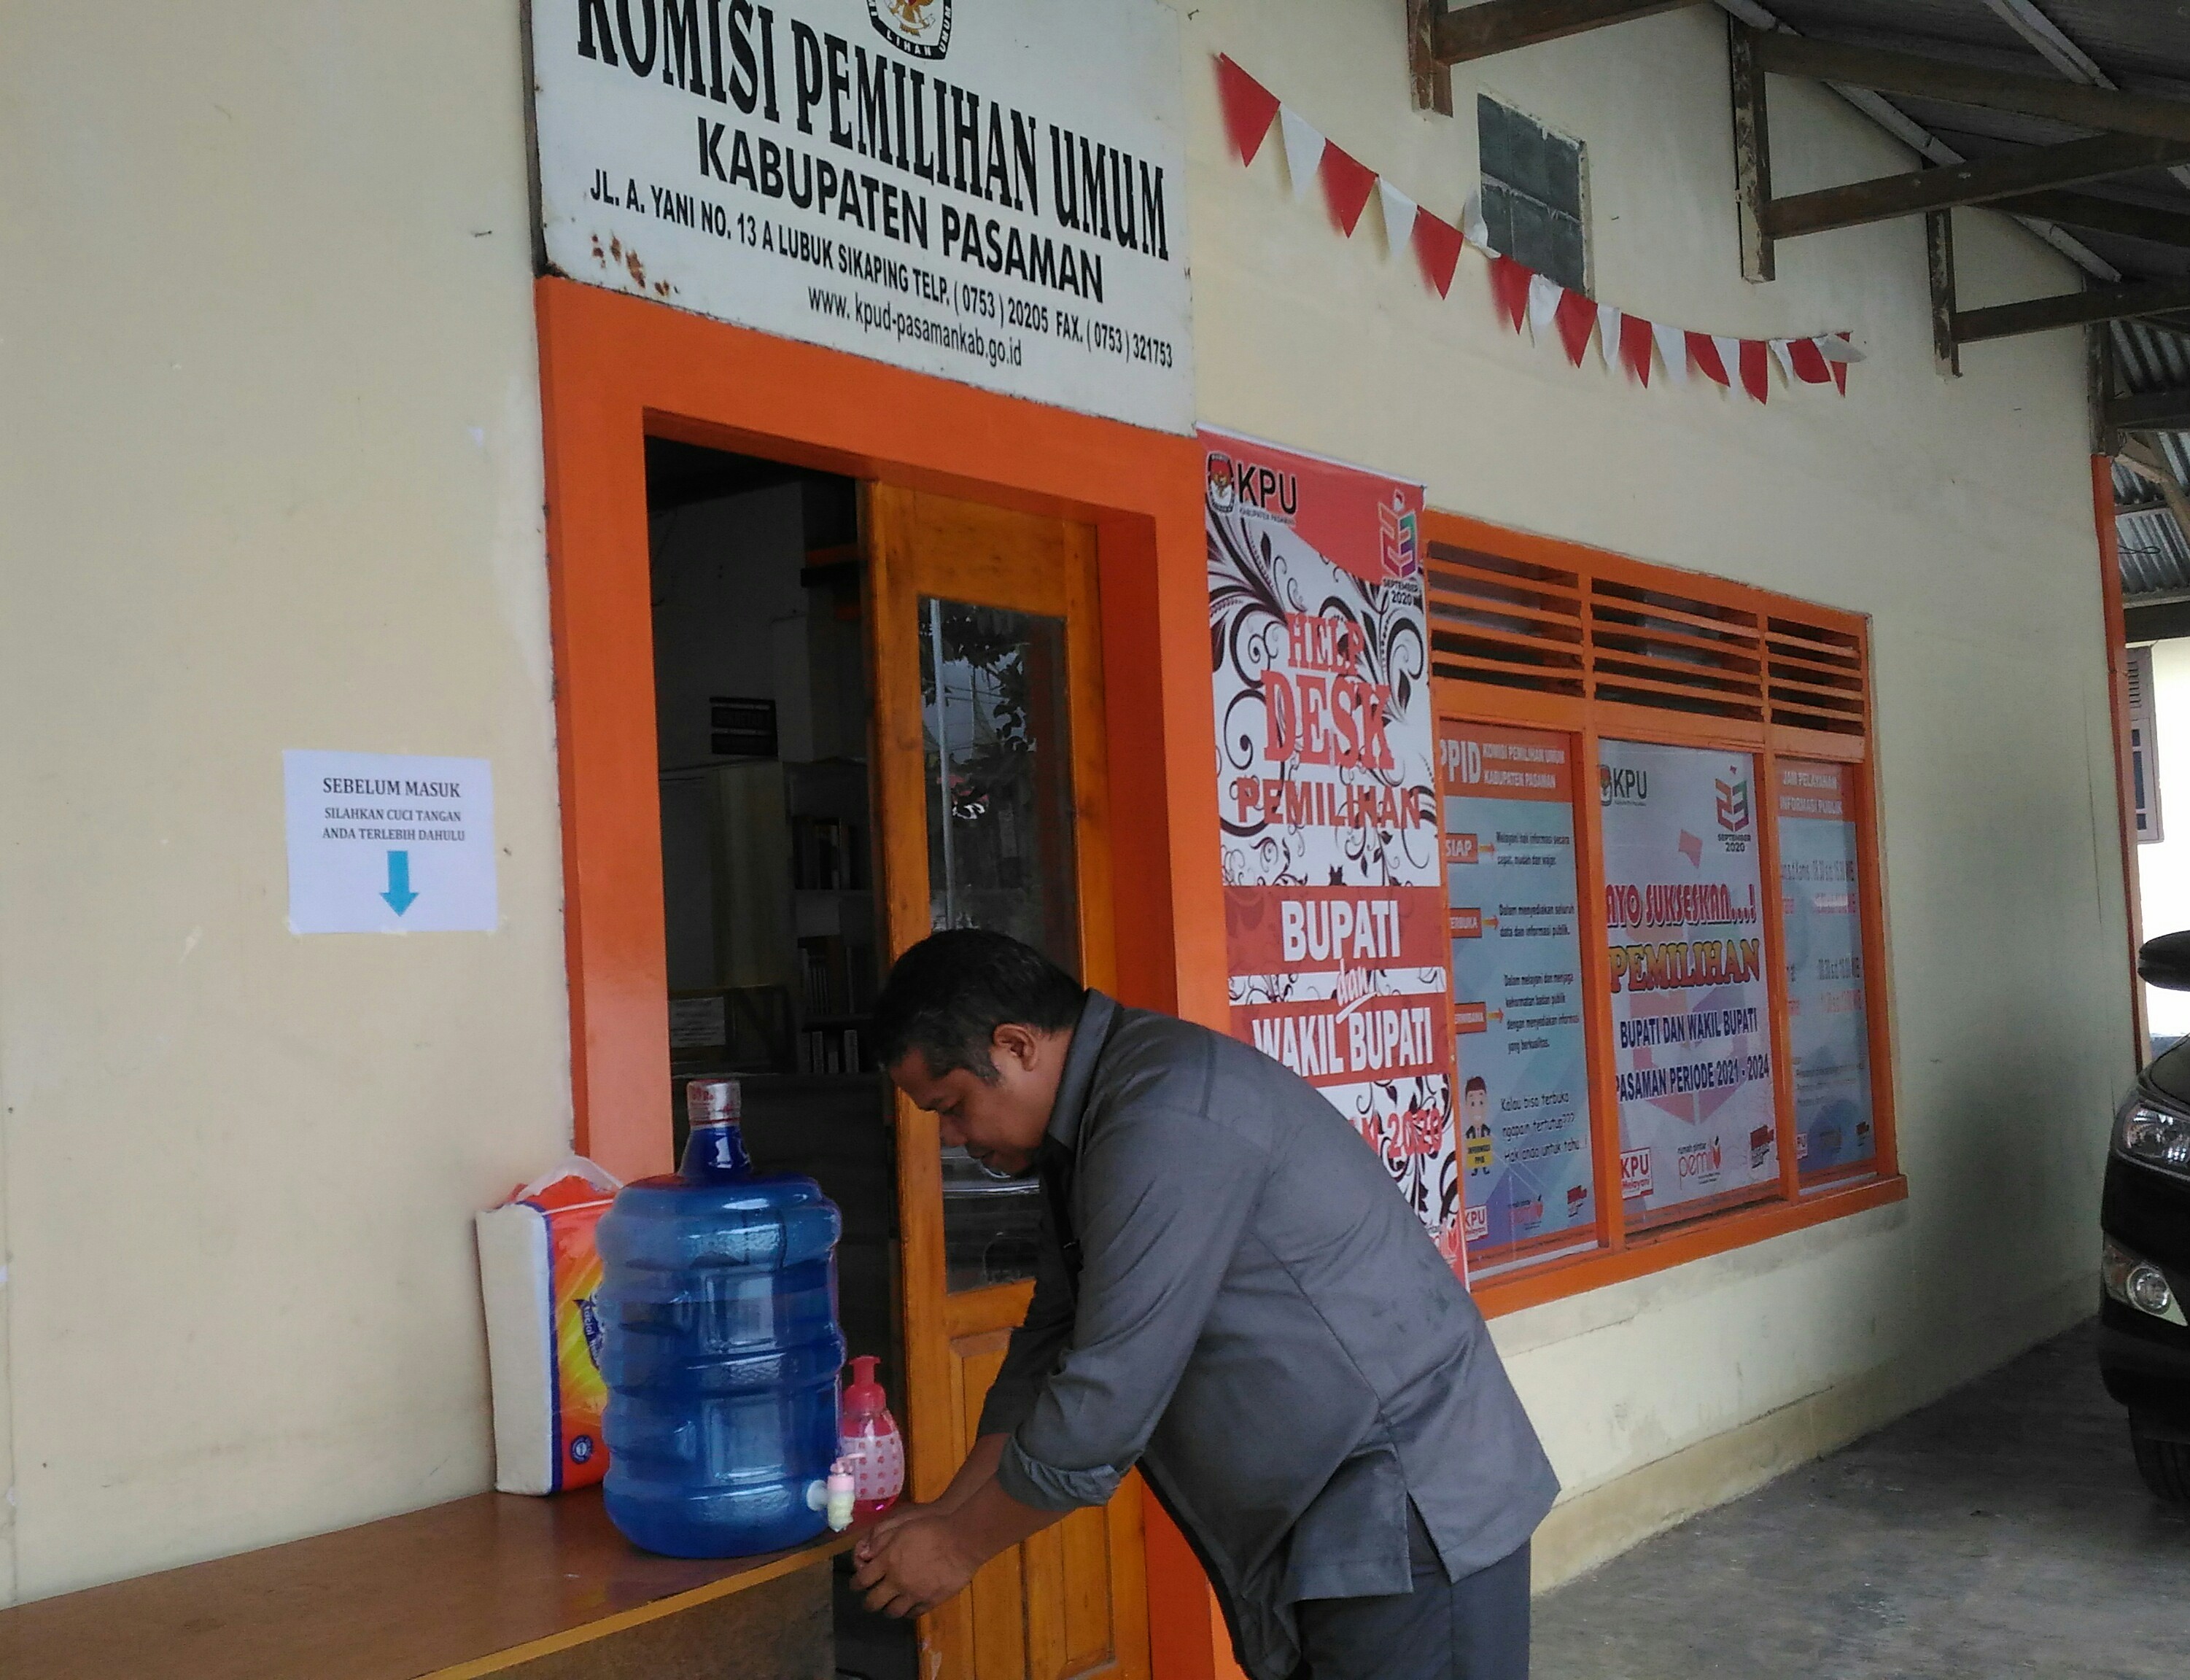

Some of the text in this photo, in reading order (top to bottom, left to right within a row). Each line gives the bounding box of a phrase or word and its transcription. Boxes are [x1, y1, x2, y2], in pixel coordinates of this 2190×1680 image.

[791, 19, 1038, 217] PEMILIHAN
[1049, 124, 1168, 261] UMUM
[698, 116, 1103, 303] KABUPATEN PASAMAN
[590, 169, 620, 206] JL.
[626, 179, 645, 214] A.
[651, 184, 694, 228] YANI
[702, 201, 731, 239] NO.
[737, 212, 756, 246] 13
[763, 220, 774, 252] A
[779, 225, 834, 270] LUBUK
[839, 244, 909, 293] SIKAPING
[912, 268, 950, 306] TELP.
[1008, 297, 1049, 334] 20205
[1057, 310, 1084, 343] FAX.
[1133, 333, 1173, 369] 321753
[1238, 462, 1296, 514] KPU
[1391, 590, 1413, 606] 2020
[1285, 612, 1366, 677] HELP
[1261, 669, 1395, 771] DESK
[322, 777, 461, 798] SEBELUM MASUK
[1237, 776, 1422, 830] PEMILIHAN
[1613, 768, 1647, 799] KPU
[322, 828, 465, 841] ANDA TERLEBIH DAHULU
[325, 807, 461, 822] SILAHKAN CUCI TANGAN
[1725, 841, 1745, 852] 2020
[1606, 884, 1643, 928] AYO
[1281, 900, 1401, 962] BUPATI
[1608, 938, 1760, 993] PEMILIHAN
[1251, 1007, 1433, 1078] WAKIL BUPATI
[1620, 1017, 1661, 1049] BUPATI
[1663, 1015, 1685, 1043] DAN
[1688, 1011, 1721, 1041] WAKIL
[1723, 1007, 1758, 1037] BUPATI
[1670, 1062, 1714, 1093] PERIODE
[1716, 1059, 1740, 1086] 2021
[1747, 1053, 1770, 1081] 2024
[1620, 1154, 1649, 1178] KPU
